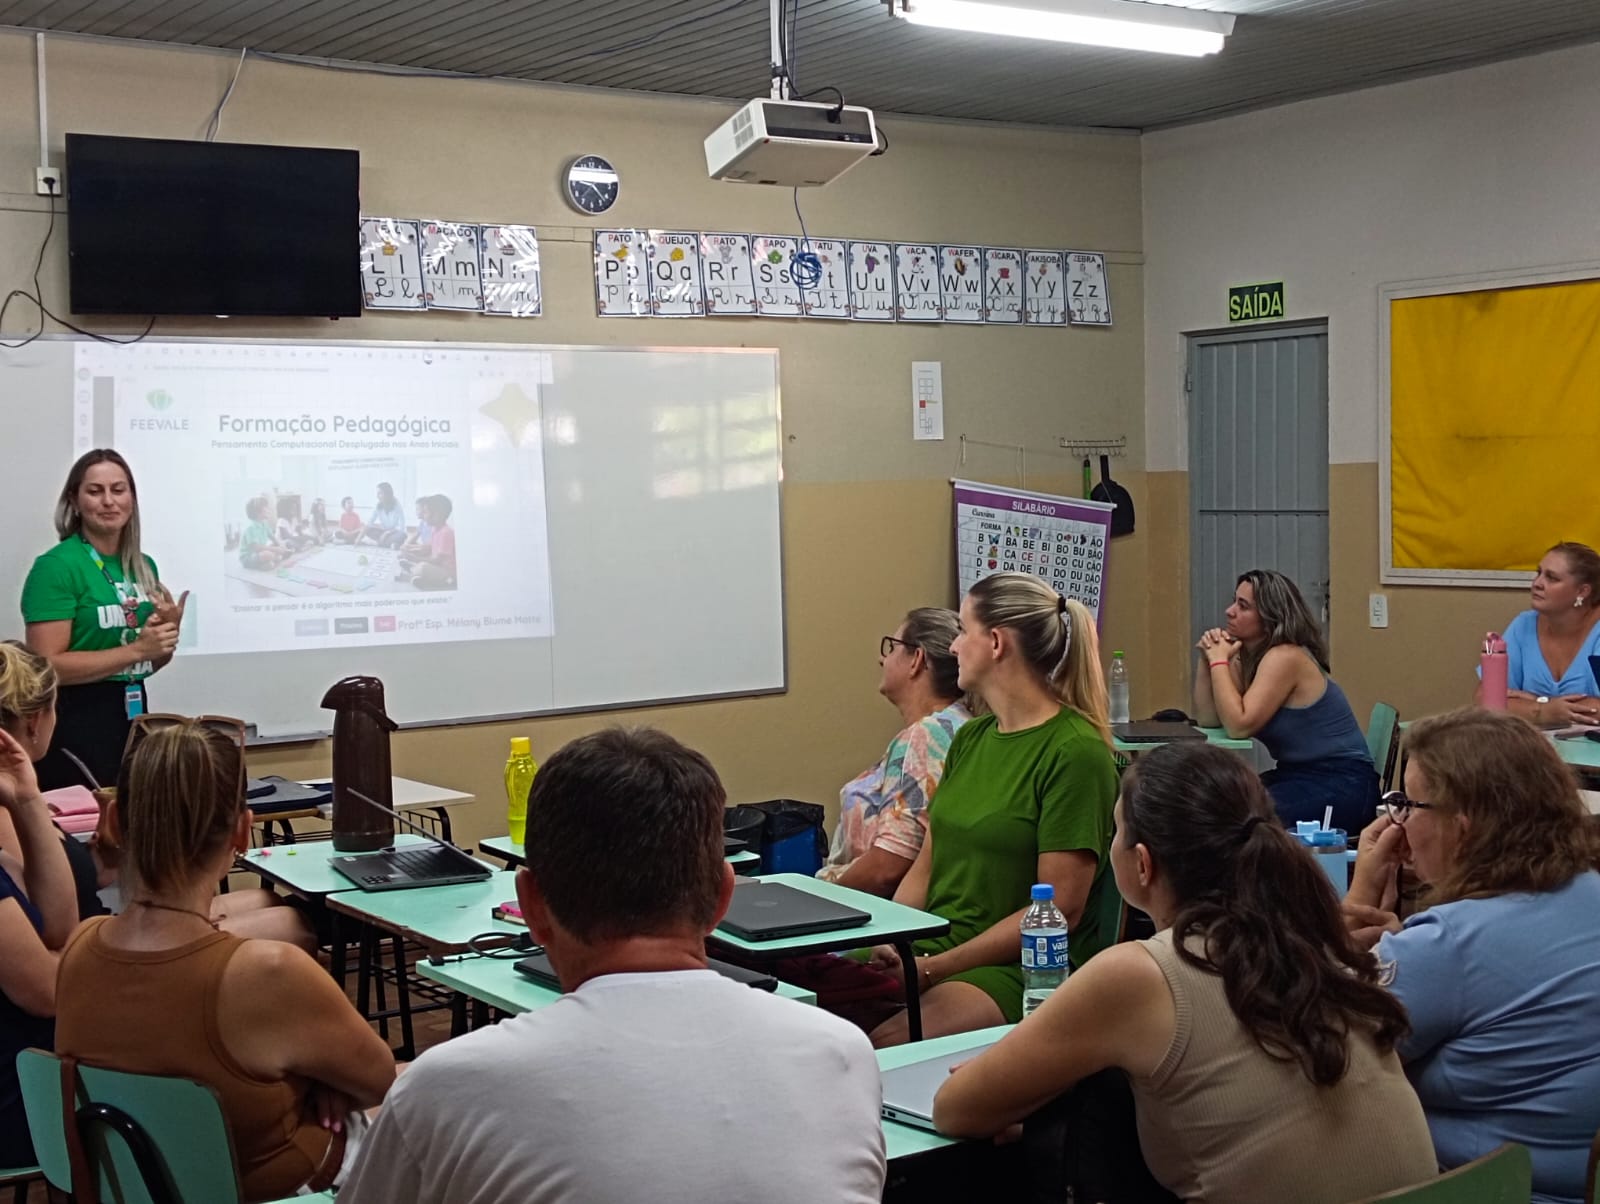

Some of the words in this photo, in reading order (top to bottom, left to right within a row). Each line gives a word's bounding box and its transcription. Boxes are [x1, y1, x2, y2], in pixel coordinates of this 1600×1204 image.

[428, 226, 472, 238] MACACO
[608, 234, 631, 242] PATO
[658, 234, 690, 244] QUEIJO
[714, 236, 736, 246] RATO
[764, 239, 786, 248] SAPO
[814, 242, 832, 250] TATU
[862, 245, 878, 253] UVA
[906, 247, 926, 255] VACA
[948, 249, 974, 258] WAFER
[1073, 255, 1096, 264] ZEBRA
[371, 254, 384, 274] L
[427, 255, 446, 276] M
[456, 260, 476, 276] m
[606, 260, 619, 280] P
[656, 260, 674, 282] Q
[709, 262, 724, 281] R
[732, 266, 738, 280] r
[760, 264, 773, 283] S
[780, 270, 790, 284] s
[828, 272, 834, 288] t
[856, 272, 868, 291] U
[875, 278, 885, 291] u
[902, 273, 914, 292] V
[920, 279, 930, 292] v
[942, 274, 959, 292] W
[964, 280, 978, 293] w
[990, 277, 1001, 295] X
[1006, 282, 1015, 296] x
[1030, 276, 1042, 293] Y
[1047, 281, 1056, 298] y
[1072, 280, 1084, 298] Z
[1088, 285, 1098, 298] z
[1230, 286, 1282, 319] SAÍDA
[130, 418, 189, 430] FEEVALE
[219, 414, 326, 436] Formação
[334, 414, 450, 437] Pedagógica
[211, 440, 268, 448] Pensamento
[270, 440, 336, 450] Computacional
[338, 440, 390, 450] Desplugado
[409, 440, 430, 449] Anos
[1012, 501, 1056, 516] SILABÁRIO
[980, 522, 1002, 530] FORMA
[1006, 526, 1012, 536] A
[1022, 528, 1028, 537] E
[1057, 533, 1063, 542] O
[1073, 536, 1078, 544] U
[978, 533, 984, 542] B
[1006, 538, 1017, 547] BA
[1023, 540, 1034, 549] BE
[1042, 542, 1050, 551] BI
[1056, 544, 1068, 554] BO
[1073, 547, 1085, 556] BU
[978, 546, 983, 554] C
[1005, 550, 1016, 559] CA
[1022, 552, 1033, 561] CE
[1041, 555, 1049, 564] CI
[1055, 557, 1067, 566] CO
[1072, 559, 1083, 568] CU
[977, 558, 982, 567] D
[1003, 562, 1015, 571] DA
[1020, 564, 1032, 573] DE
[1039, 566, 1047, 575] DI
[1054, 569, 1066, 578] DO
[1071, 571, 1082, 580] DU
[1053, 581, 1064, 590] FO
[1070, 583, 1080, 592] FU
[483, 616, 512, 626] Blume
